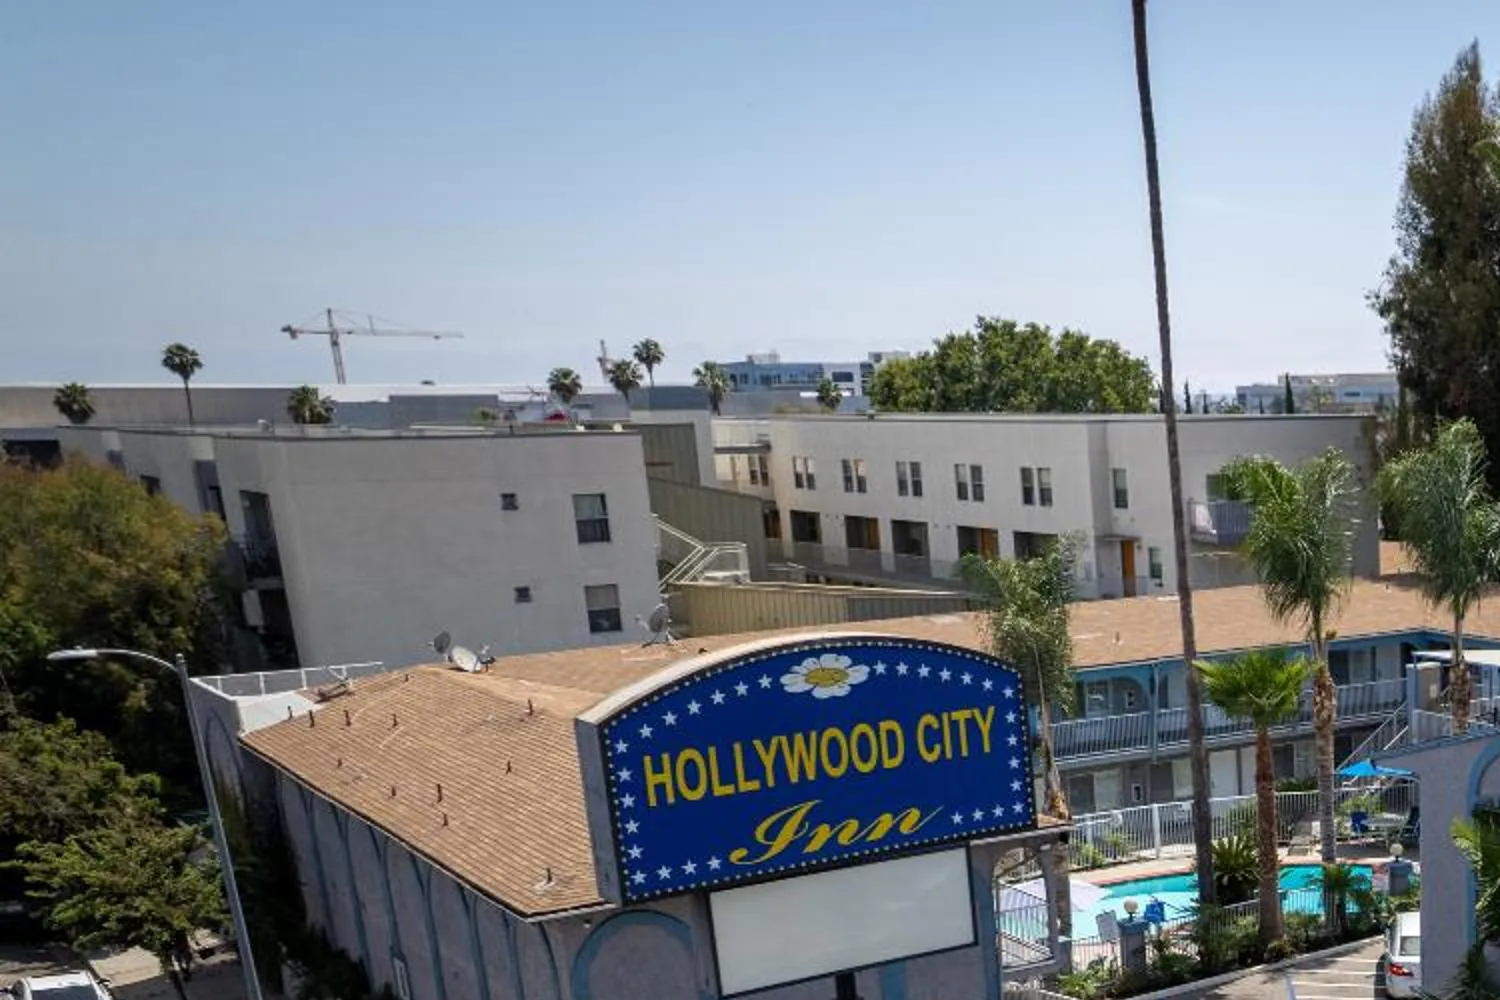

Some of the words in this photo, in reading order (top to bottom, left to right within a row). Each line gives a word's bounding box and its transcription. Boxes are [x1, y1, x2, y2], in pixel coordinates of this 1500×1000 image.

[643, 718, 906, 808] HOLLYWOOD
[916, 705, 996, 764] CITY
[728, 800, 945, 866] Inn
